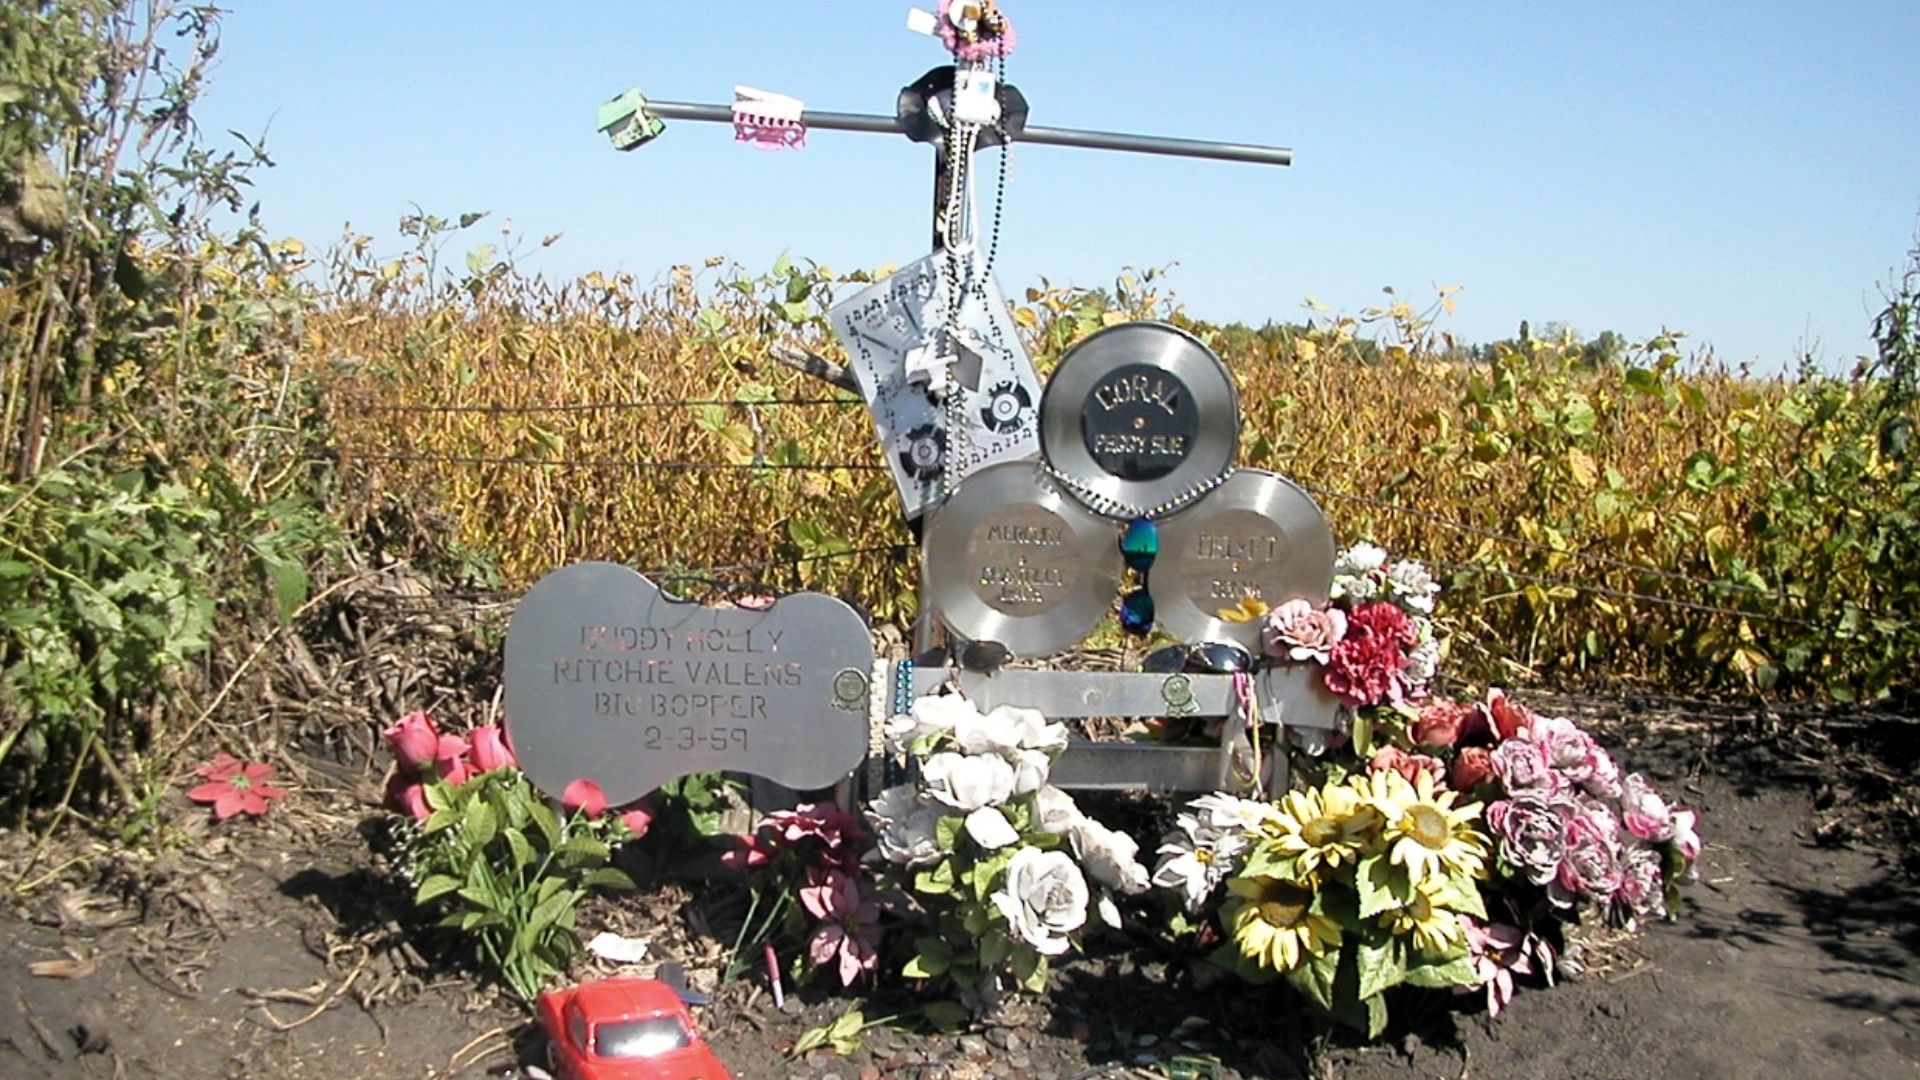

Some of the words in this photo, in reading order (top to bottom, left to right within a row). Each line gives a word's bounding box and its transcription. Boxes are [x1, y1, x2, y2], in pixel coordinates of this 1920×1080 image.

[579, 625, 675, 652] BUDDY
[686, 627, 784, 654] HOLLY
[553, 657, 675, 685] RITCHIE
[684, 660, 804, 687] VALENS
[651, 692, 769, 720] BOPPER
[643, 724, 750, 752] 2-3-59
